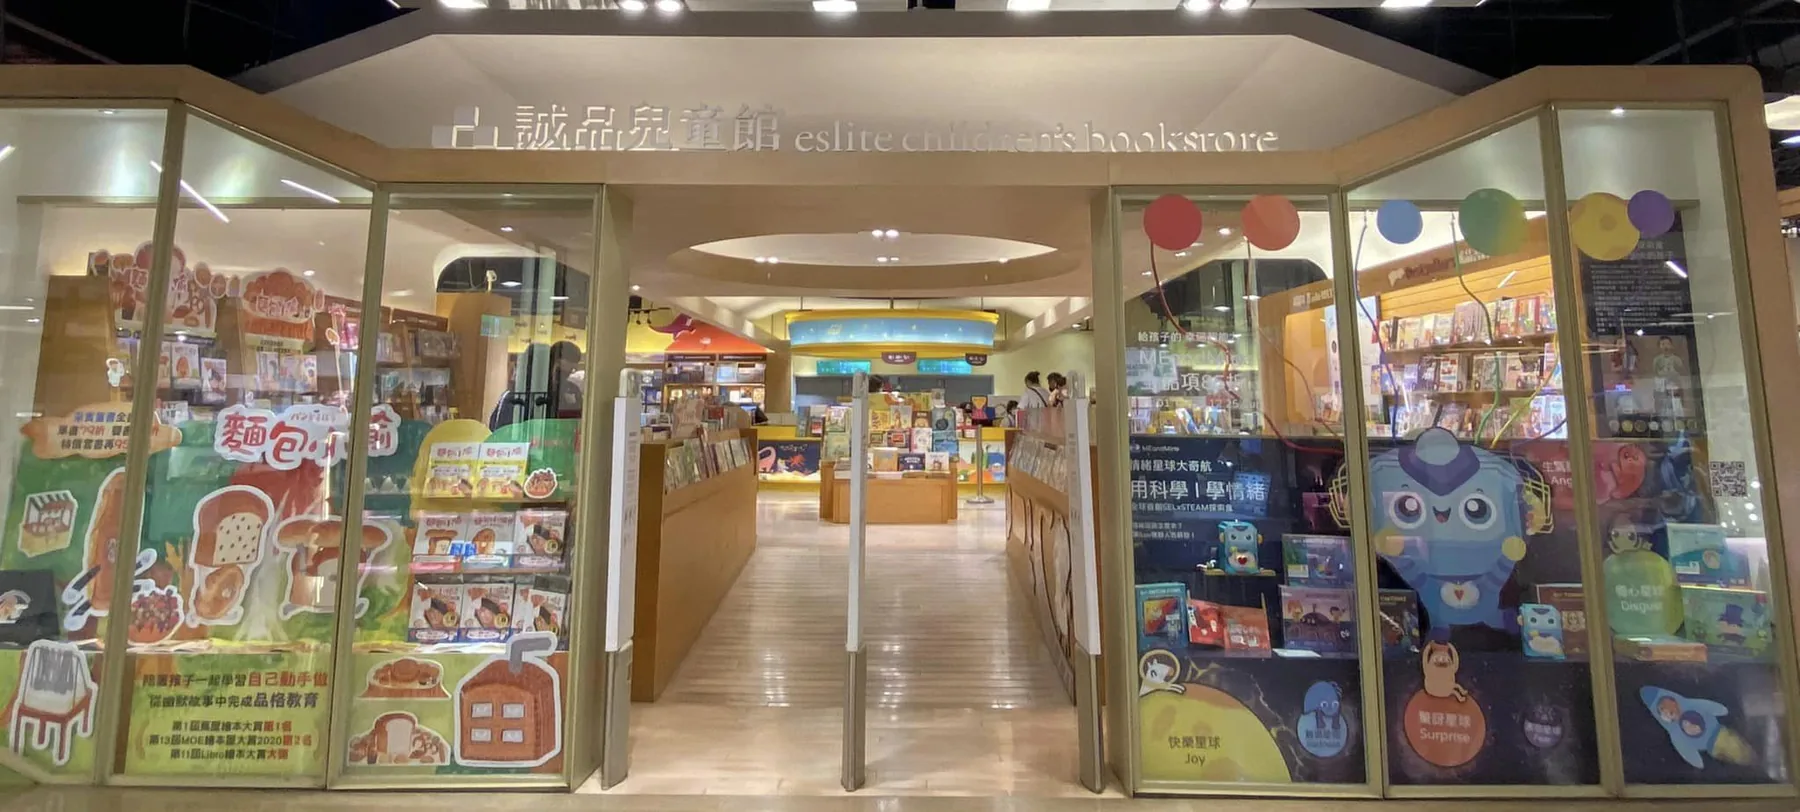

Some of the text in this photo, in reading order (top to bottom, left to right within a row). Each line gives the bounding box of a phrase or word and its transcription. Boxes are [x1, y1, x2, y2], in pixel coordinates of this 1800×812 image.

[514, 103, 1280, 153] 誠品兒童館 eslite children's bookstore
[1138, 331, 1182, 343] 給孩子的
[1131, 480, 1189, 501] 用科學
[1206, 480, 1266, 501] 學情緒
[1168, 735, 1221, 750] 快樂星球
[1420, 728, 1470, 744] Surprise
[1184, 753, 1206, 766] Joy
